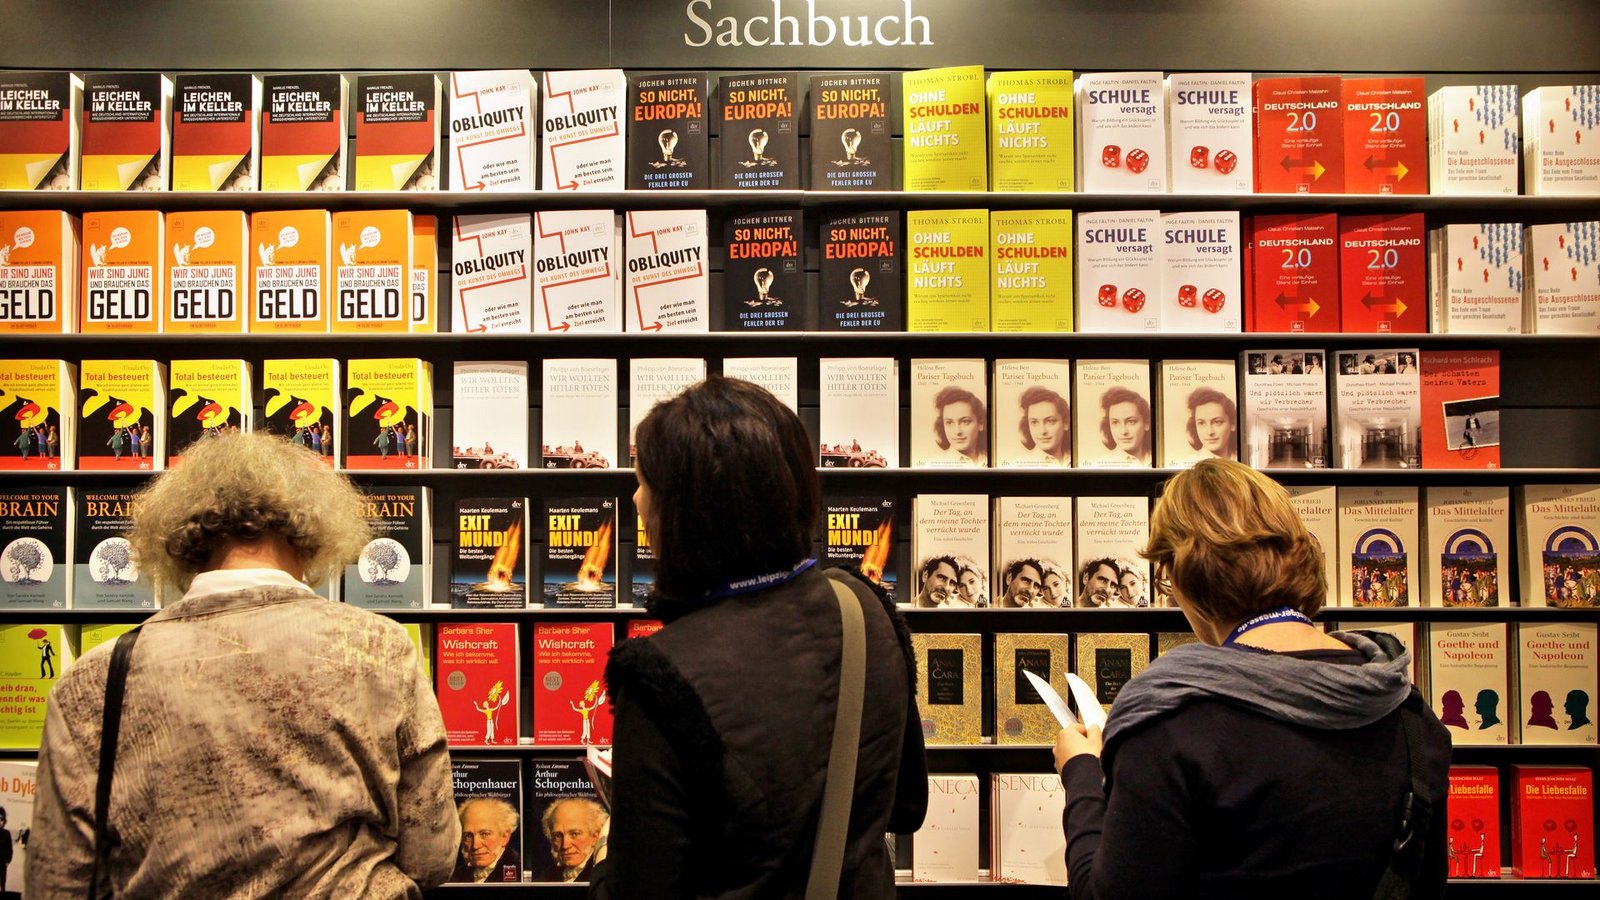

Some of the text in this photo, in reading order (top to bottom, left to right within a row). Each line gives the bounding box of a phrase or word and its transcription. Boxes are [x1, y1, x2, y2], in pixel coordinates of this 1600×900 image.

[684, 0, 934, 47] Sachbuch
[183, 92, 231, 102] LEICHEN
[272, 92, 320, 102] LEICHEN
[366, 92, 414, 102] LEICHEN
[640, 89, 698, 103] SO NICHT,
[909, 90, 946, 104] OHNE
[998, 92, 1035, 104] OHNE
[1089, 90, 1150, 104] SCHULE
[1177, 91, 1238, 105] SCHULE
[183, 102, 242, 112] IM KELLER
[272, 102, 331, 112] IM KELLER
[366, 102, 425, 112] IM KELLER
[910, 103, 980, 118] SCHULDEN
[1120, 105, 1156, 115] versagt
[1209, 106, 1244, 116] versagt
[1264, 101, 1338, 110] DEUTSCHLAND
[1348, 102, 1422, 111] DEUTSCHLAND
[634, 103, 702, 121] EUROPA!
[999, 107, 1068, 119] SCHULDEN
[452, 106, 524, 133] OBLIQUITY
[545, 106, 617, 133] OBLIQUITY
[1286, 111, 1317, 132] 2.0
[1369, 112, 1400, 132] 2.0
[910, 120, 951, 134] LÄUFT
[999, 122, 1040, 134] LÄUFT
[911, 134, 959, 147] NICHTS
[999, 136, 1048, 148] NICHTS
[1448, 157, 1515, 167] Die Ausgeschlossenen
[734, 217, 760, 225] JOCHEN
[657, 226, 684, 236] JOHN KAY
[735, 227, 793, 240] SO NICHT,
[831, 228, 889, 241] SO NICHT,
[1085, 228, 1147, 243] SCHULE
[913, 232, 950, 244] OHNE
[1259, 238, 1334, 247] DEUTSCHLAND
[730, 241, 797, 259] EUROPA!
[826, 241, 893, 259] EUROPA!
[914, 246, 983, 258] SCHULDEN
[1116, 244, 1153, 254] versagt
[537, 247, 608, 273] OBLIQUITY
[629, 247, 701, 273] OBLIQUITY
[1281, 248, 1312, 269] 2.0
[90, 268, 149, 279] WIR SIND JUNG
[914, 262, 955, 274] LÄUFT
[104, 280, 135, 288] BRAUCHEN
[914, 276, 963, 288] NICHTS
[90, 289, 149, 319] GELD
[259, 289, 318, 319] GELD
[340, 289, 399, 319] GELD
[1451, 296, 1519, 305] Die Ausgeschlossenen
[667, 310, 685, 319] besten
[666, 316, 698, 327] Ziel erreicht
[744, 319, 764, 327] FEHLER
[86, 373, 149, 381] Total besteuert
[352, 372, 413, 380] Total besteuert
[942, 373, 974, 381] Tagebuch
[827, 382, 887, 391] HITLER TÖTEN
[1357, 390, 1394, 398] plötzlich
[0, 502, 59, 517] BRAIN
[948, 509, 962, 517] Tag,
[1365, 507, 1414, 515] Mittelalter
[460, 515, 491, 531] EXIT
[549, 515, 581, 531] EXIT
[460, 531, 508, 548] MUNDI
[549, 531, 599, 547] MUNDI
[475, 627, 494, 635] Sher
[443, 639, 498, 650] Wishcraft
[539, 639, 595, 650] Wishcraft
[1437, 640, 1499, 649] Goethe und
[466, 651, 495, 659] bekomme,
[1444, 651, 1494, 661] Napoleon
[15, 695, 26, 703] dir
[535, 770, 558, 778] Arthur
[452, 778, 517, 791] chopenhauer
[1001, 776, 1064, 792] SENECA
[1450, 784, 1494, 794] Liebesfalle
[1525, 785, 1588, 796] Die Liebesfalle
